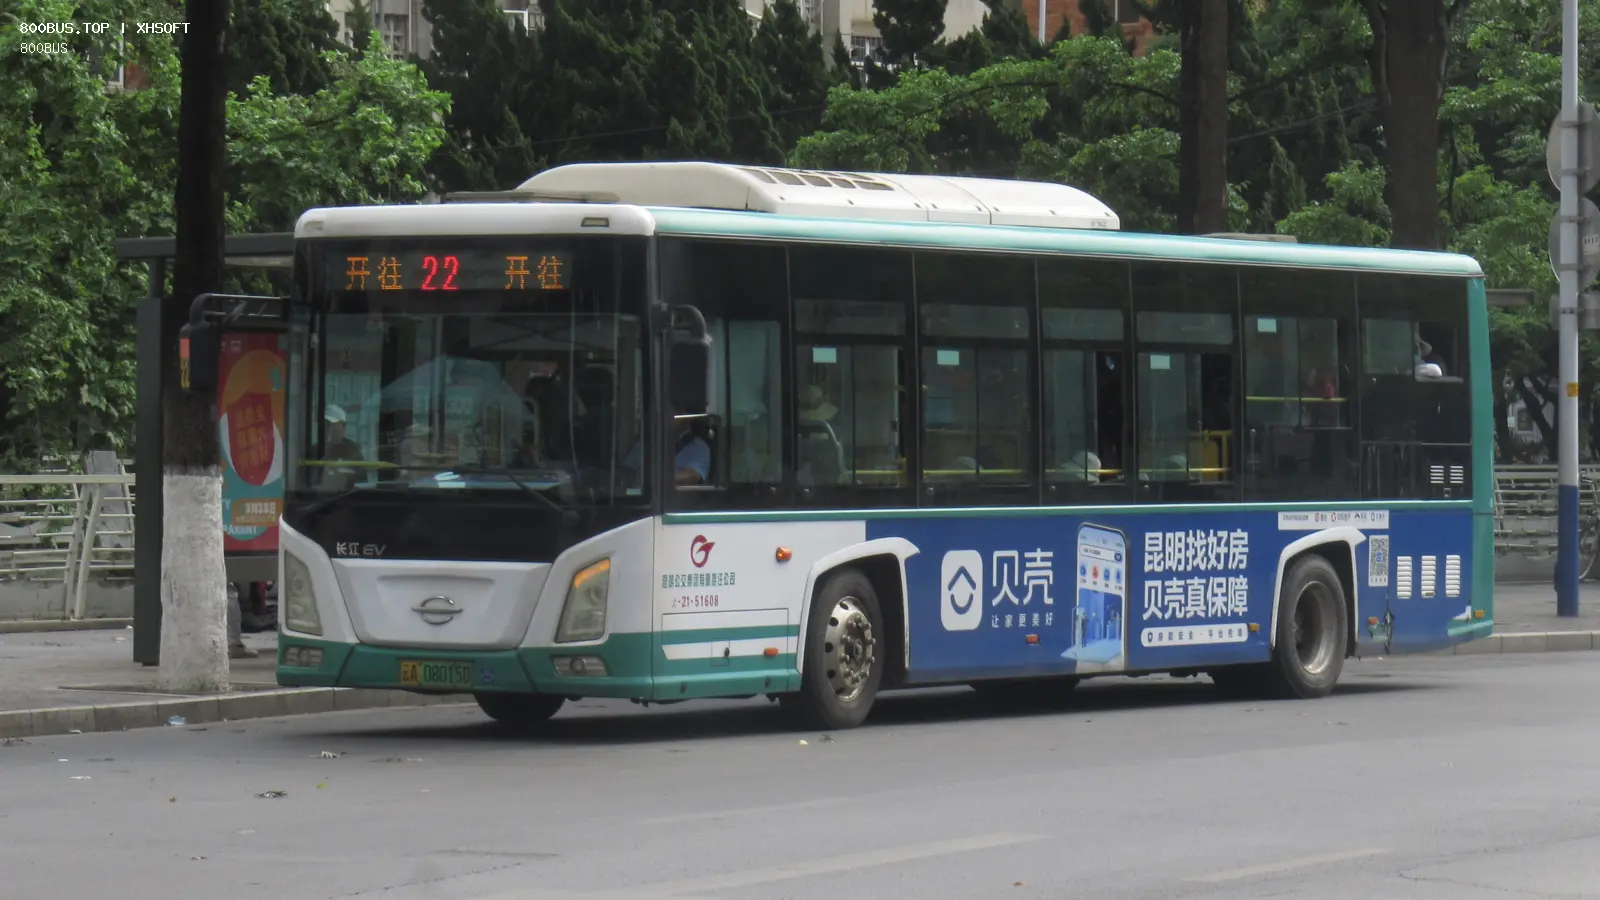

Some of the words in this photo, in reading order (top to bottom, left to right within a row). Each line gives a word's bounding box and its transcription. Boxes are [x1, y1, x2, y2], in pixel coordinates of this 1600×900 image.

[345, 256, 403, 290] 开往
[421, 256, 460, 290] 22
[504, 256, 564, 290] 开往
[336, 541, 360, 556] 长江
[363, 543, 387, 556] EV
[1143, 528, 1249, 573] 昆明找好房
[991, 547, 1054, 607] 贝壳
[1142, 574, 1249, 621] 贝壳真保障
[991, 611, 1054, 629] 让家更美好
